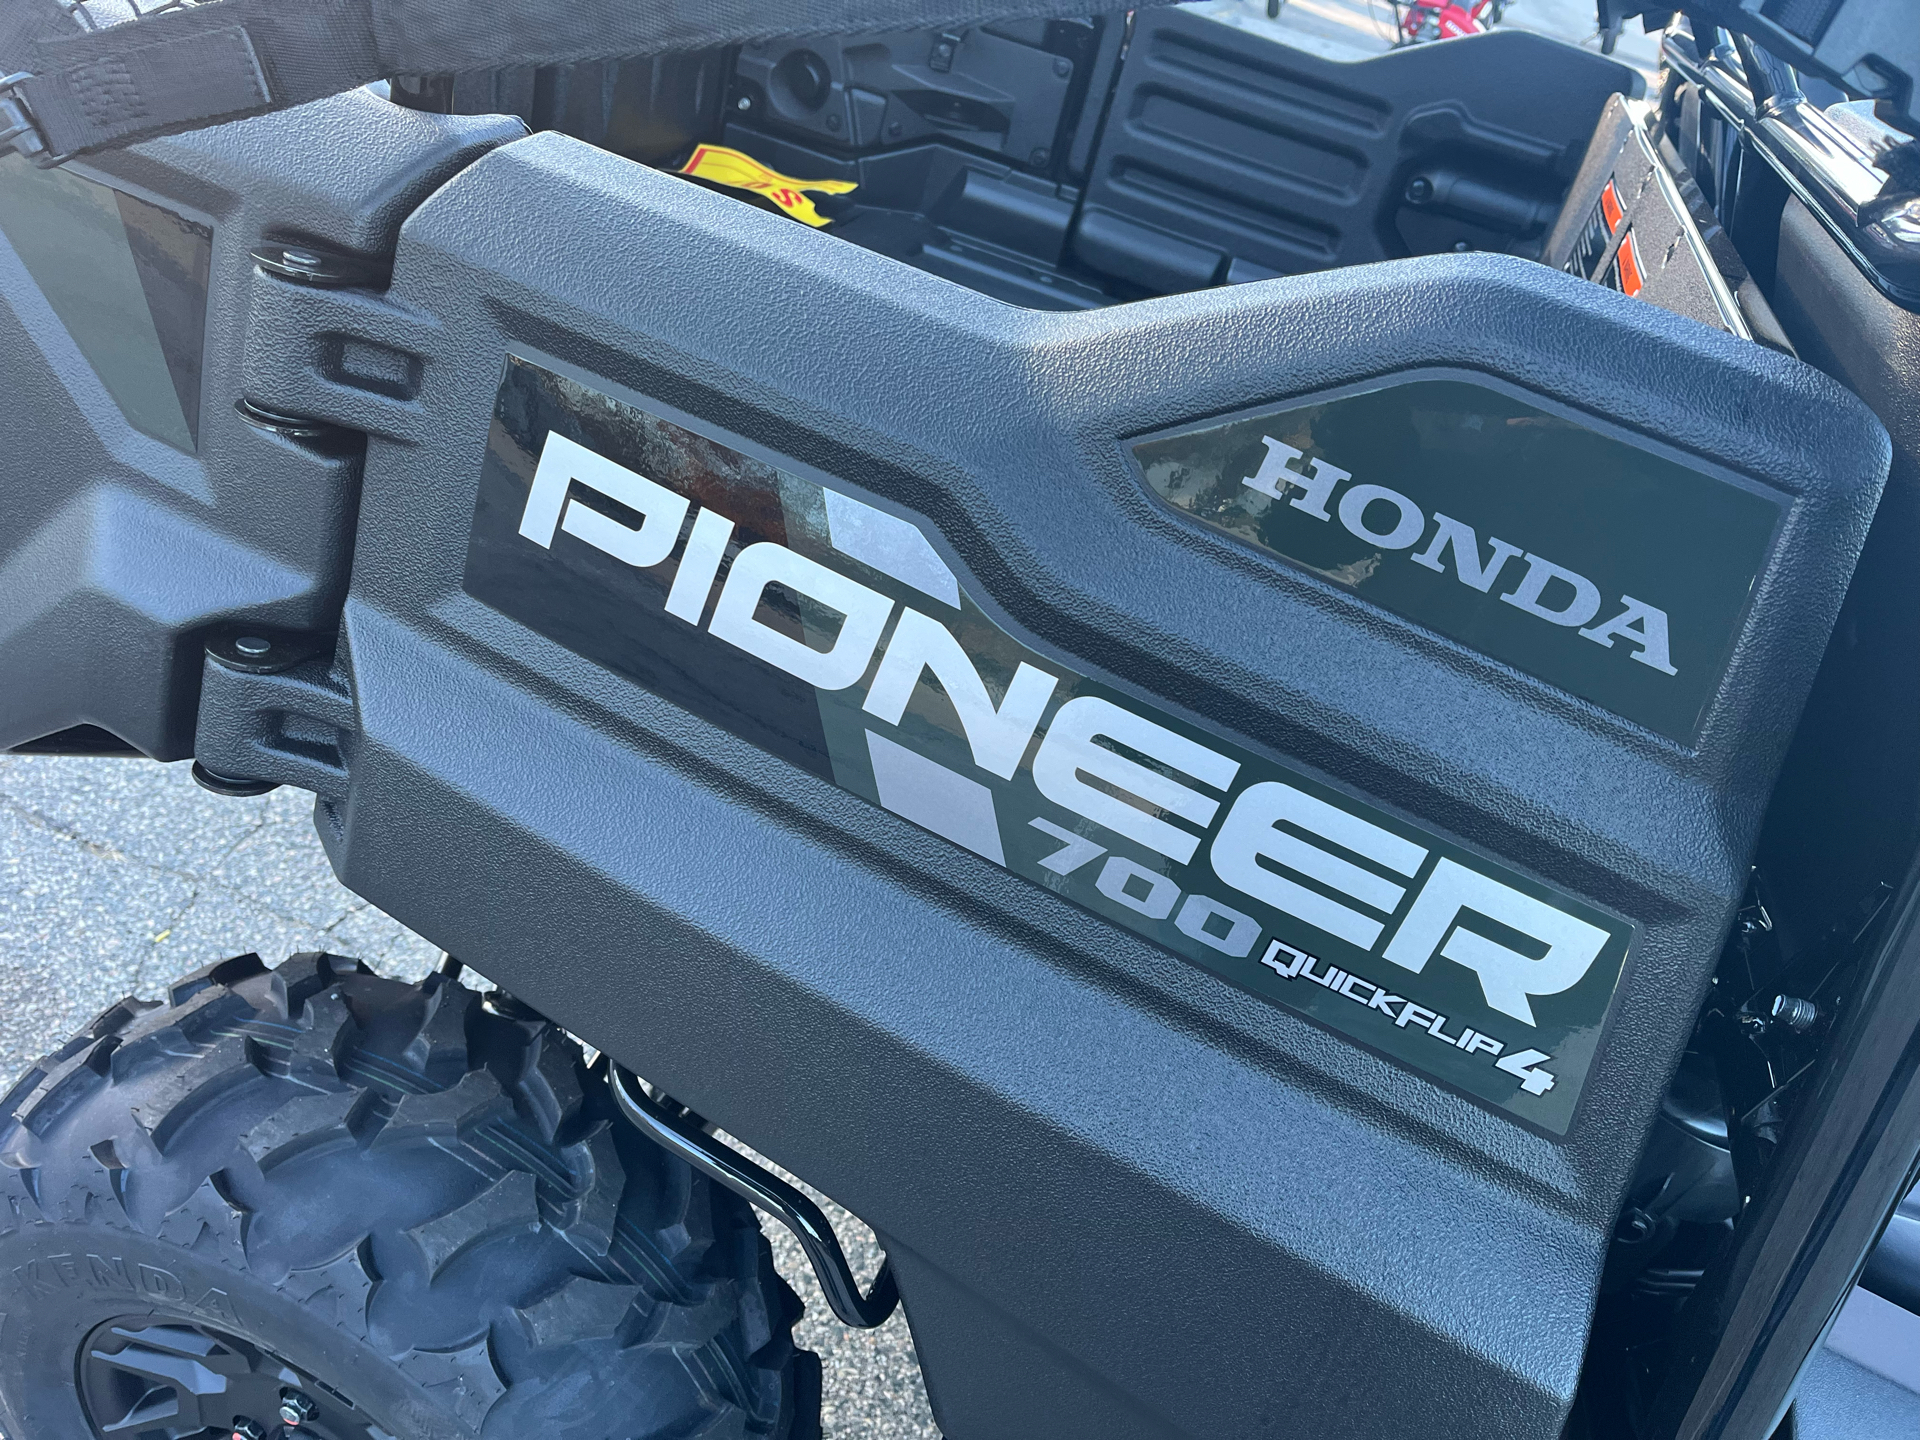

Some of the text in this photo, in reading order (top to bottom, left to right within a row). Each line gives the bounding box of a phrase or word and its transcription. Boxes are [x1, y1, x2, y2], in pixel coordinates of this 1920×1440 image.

[1242, 435, 1678, 676] HONDA
[519, 430, 1610, 1027] PIONEER
[1028, 817, 1262, 958] 700
[12, 1253, 243, 1328] KENDA
